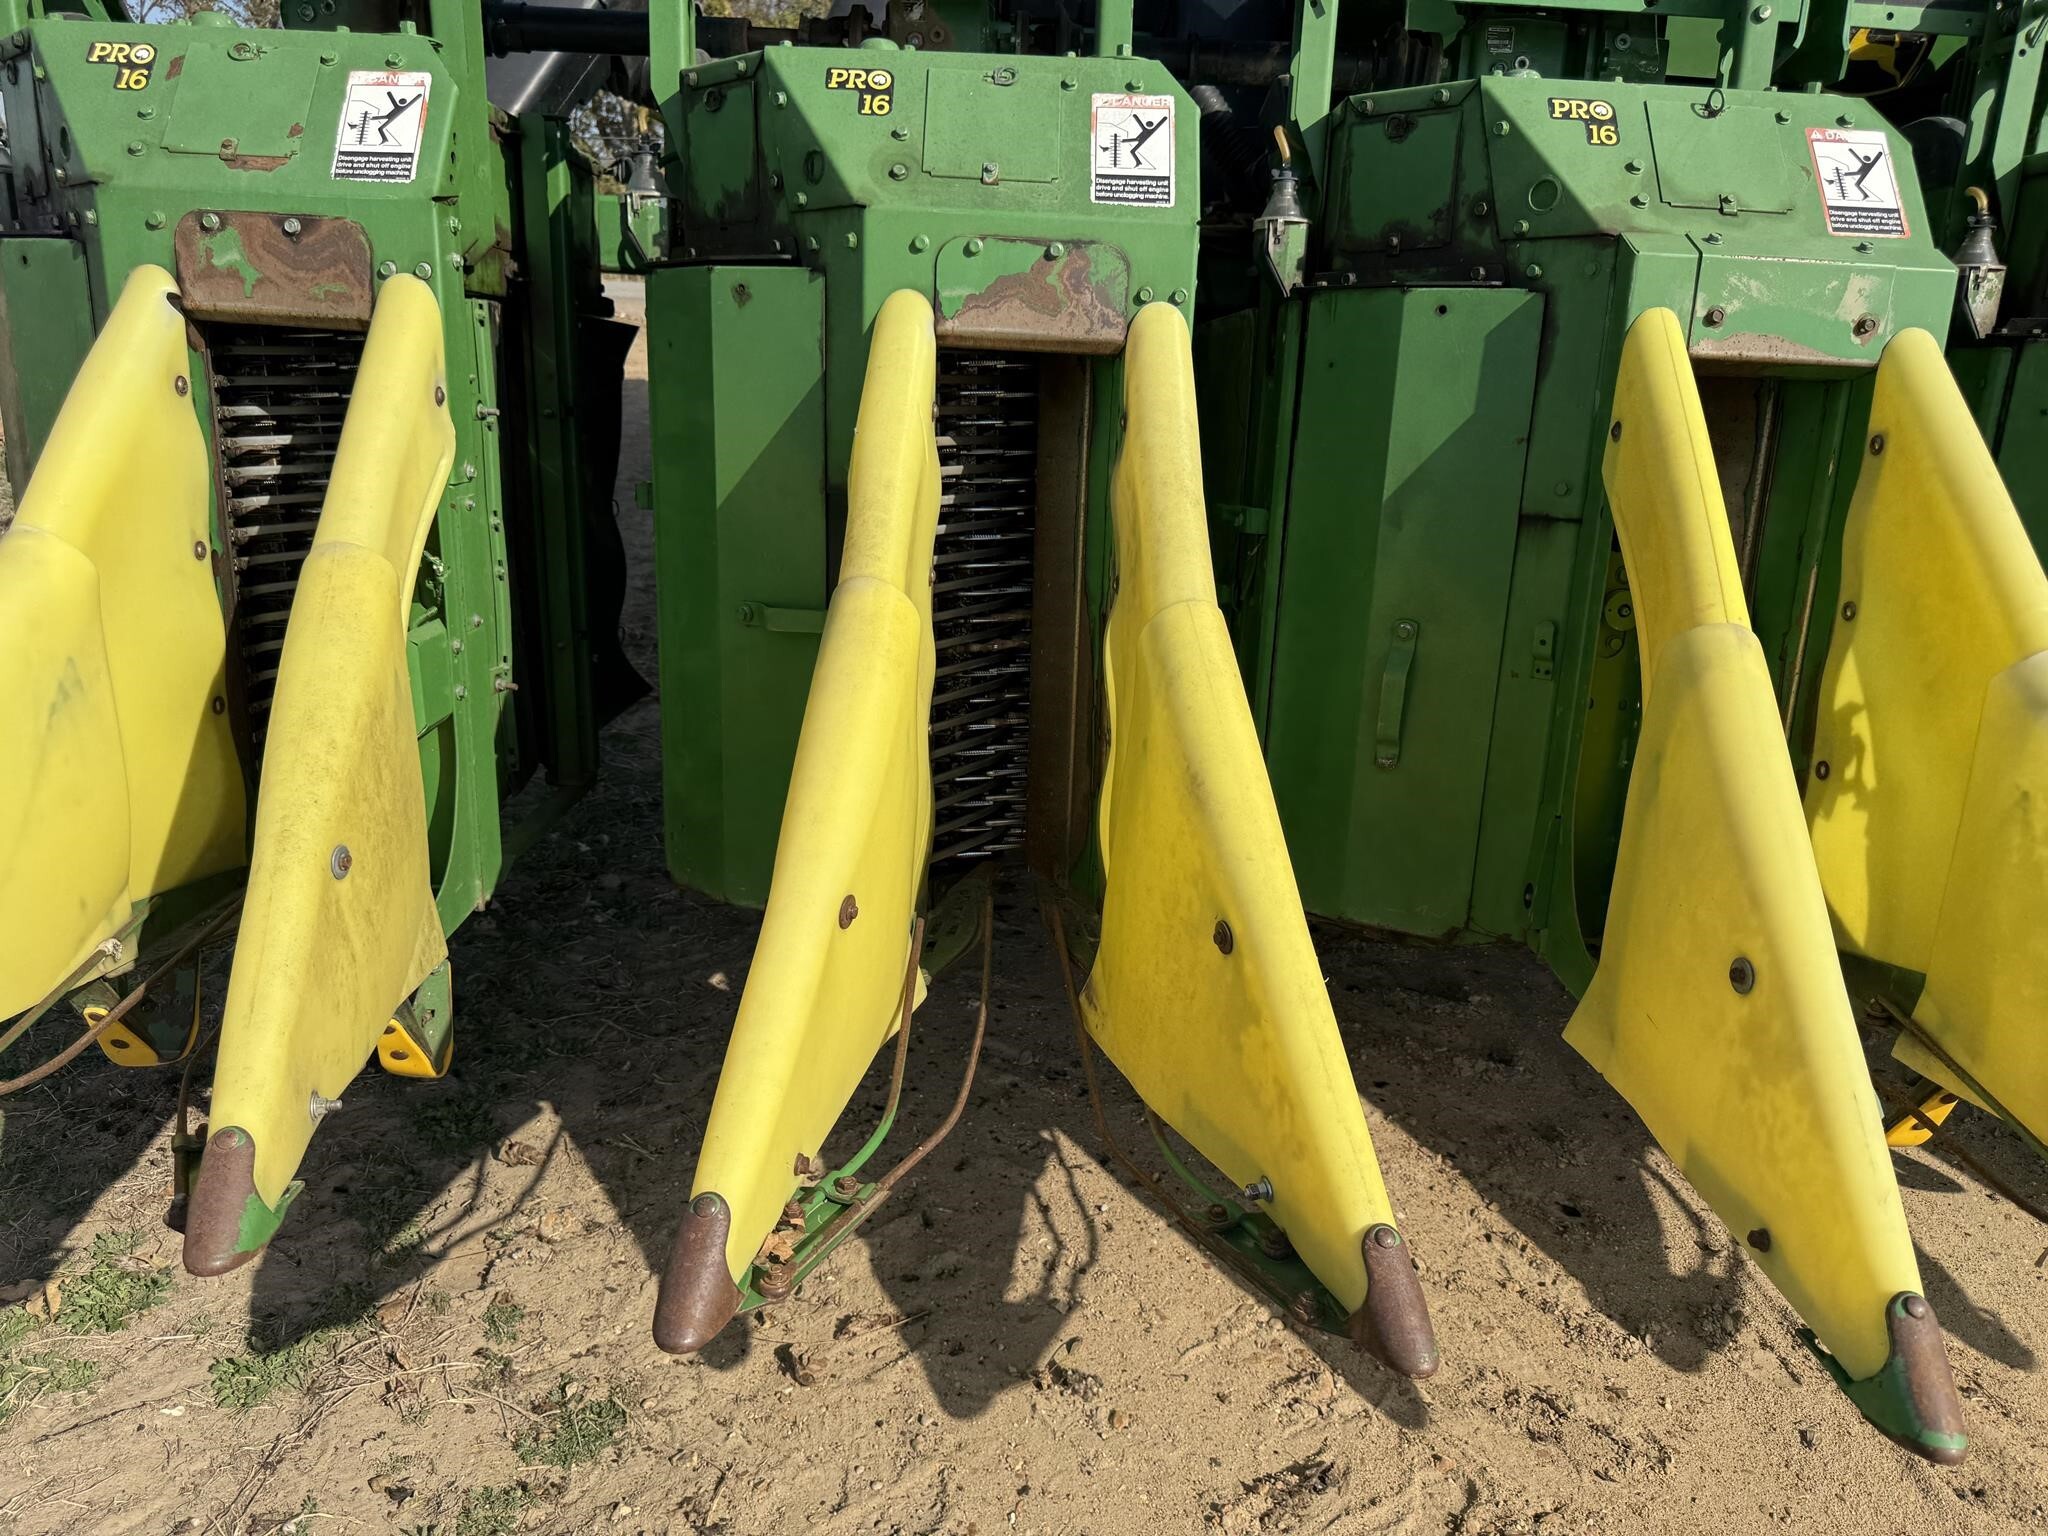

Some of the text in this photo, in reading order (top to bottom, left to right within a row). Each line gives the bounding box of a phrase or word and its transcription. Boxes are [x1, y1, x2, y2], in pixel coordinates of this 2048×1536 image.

[88, 42, 155, 65] PRO
[116, 68, 149, 90] 16
[827, 68, 892, 91] PRO
[861, 94, 890, 115] 16
[1551, 99, 1613, 121] PRO
[1589, 124, 1618, 145] 16
[338, 154, 368, 163] Disengage
[369, 155, 400, 164] harvesting
[1096, 177, 1126, 186] Disengage
[1126, 178, 1157, 187] harvesting
[1148, 186, 1169, 194] engine
[1113, 191, 1144, 200] unclogging
